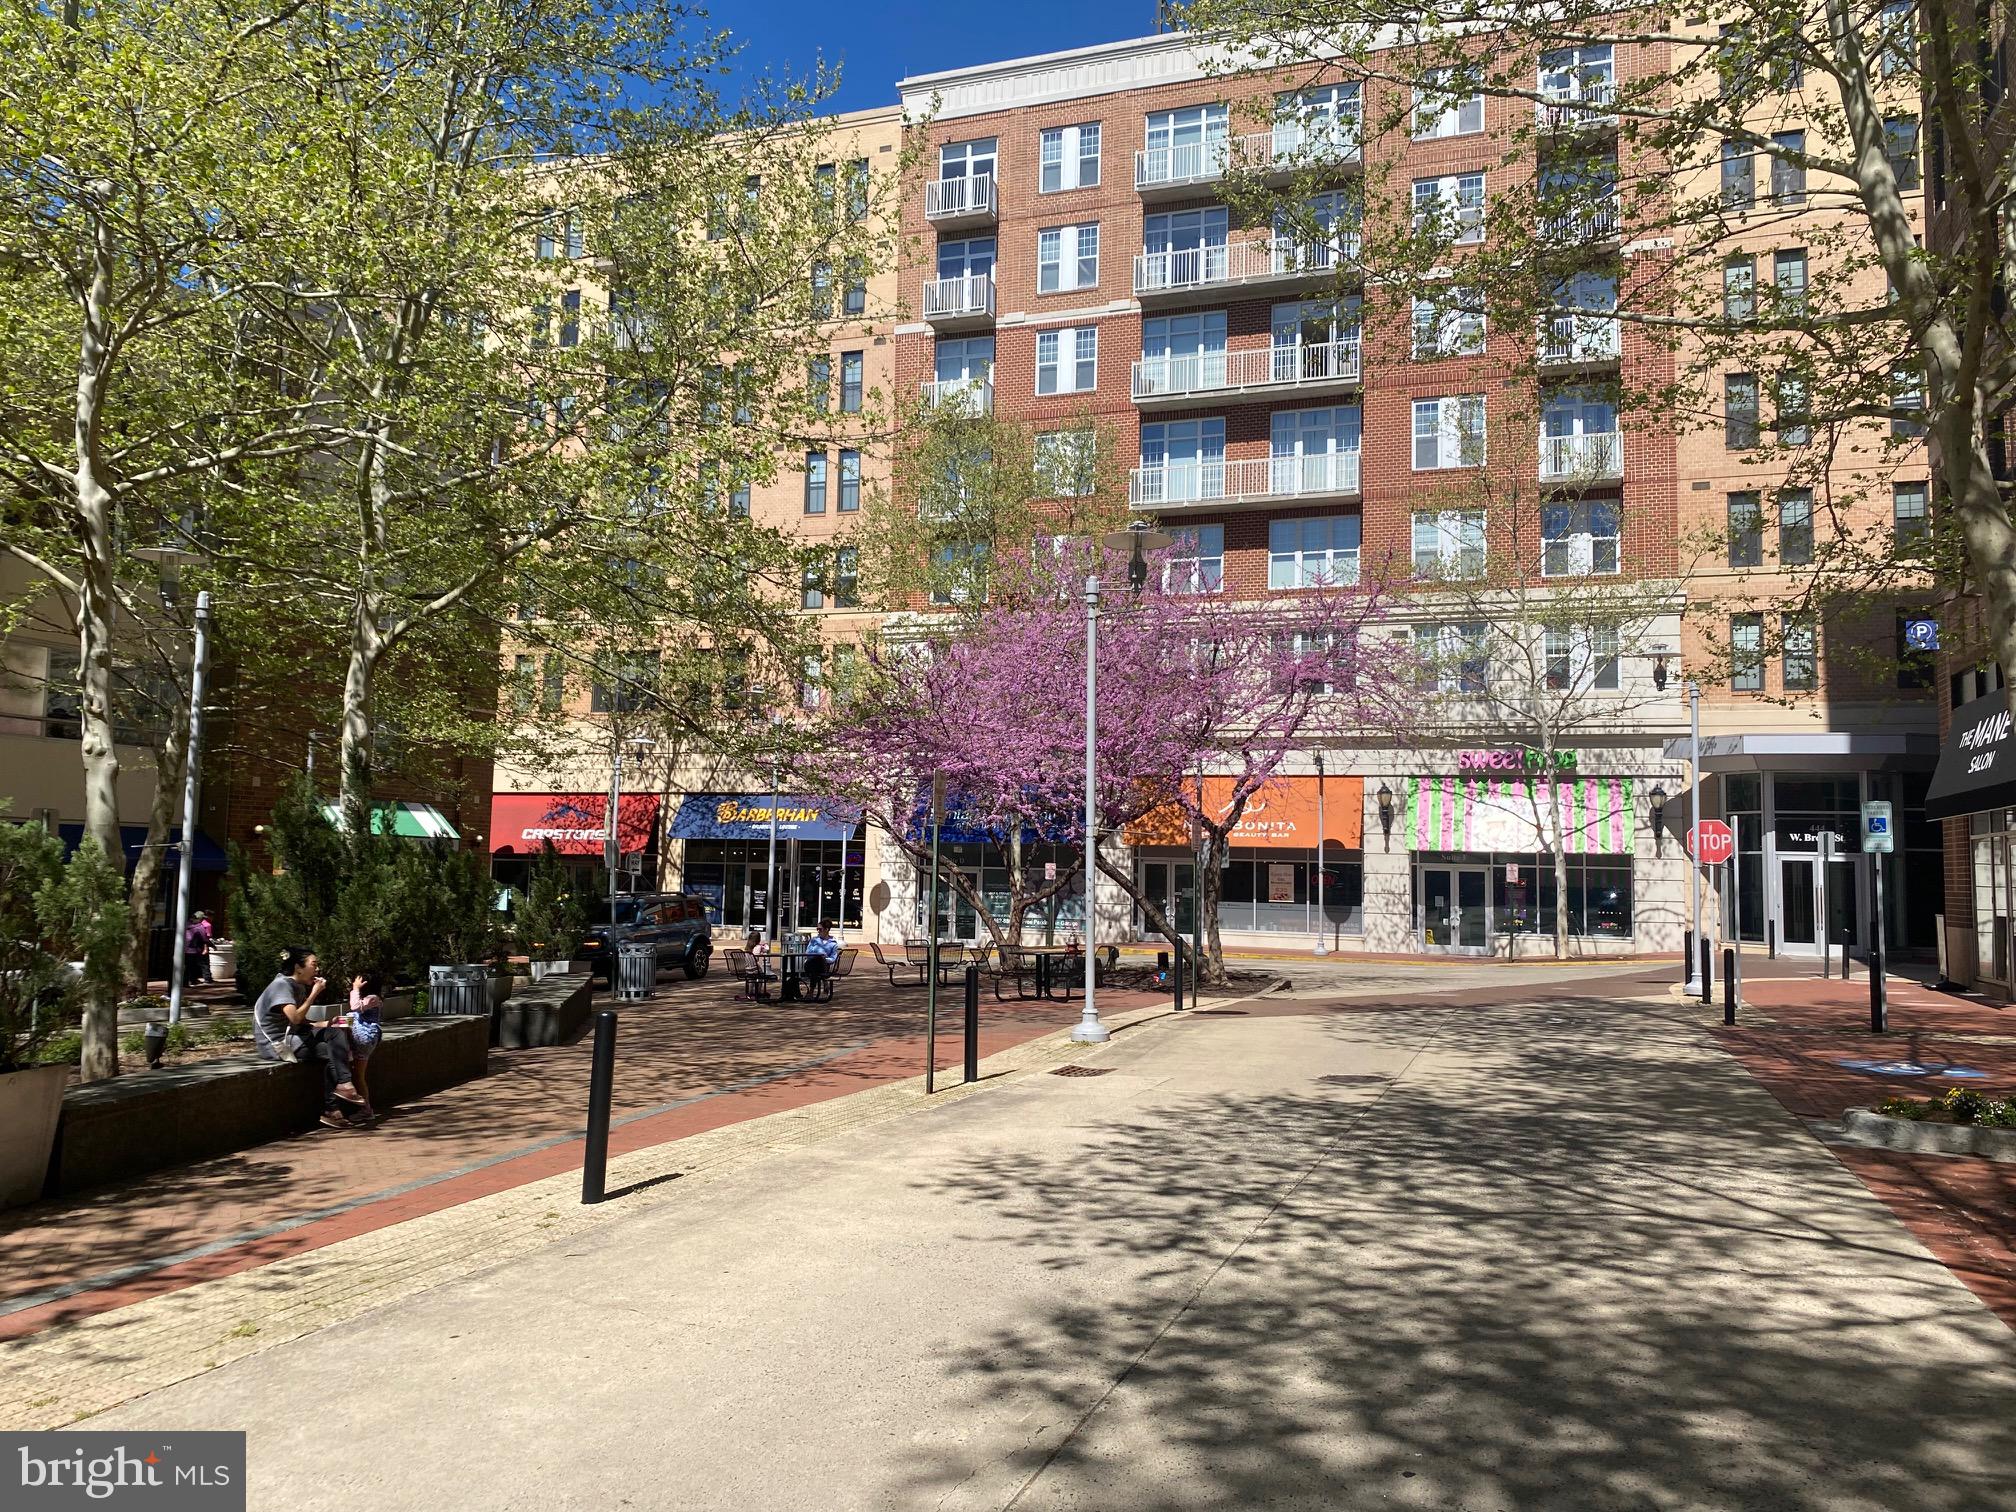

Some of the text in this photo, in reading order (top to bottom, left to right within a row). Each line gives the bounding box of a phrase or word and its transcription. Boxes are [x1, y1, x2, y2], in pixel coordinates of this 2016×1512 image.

[1959, 709, 2011, 750] THE MANE
[1968, 750, 1996, 773] SALON
[1232, 820, 1297, 831] BONITA
[1690, 833, 1732, 850] TOP
[1789, 833, 1803, 842] W.
